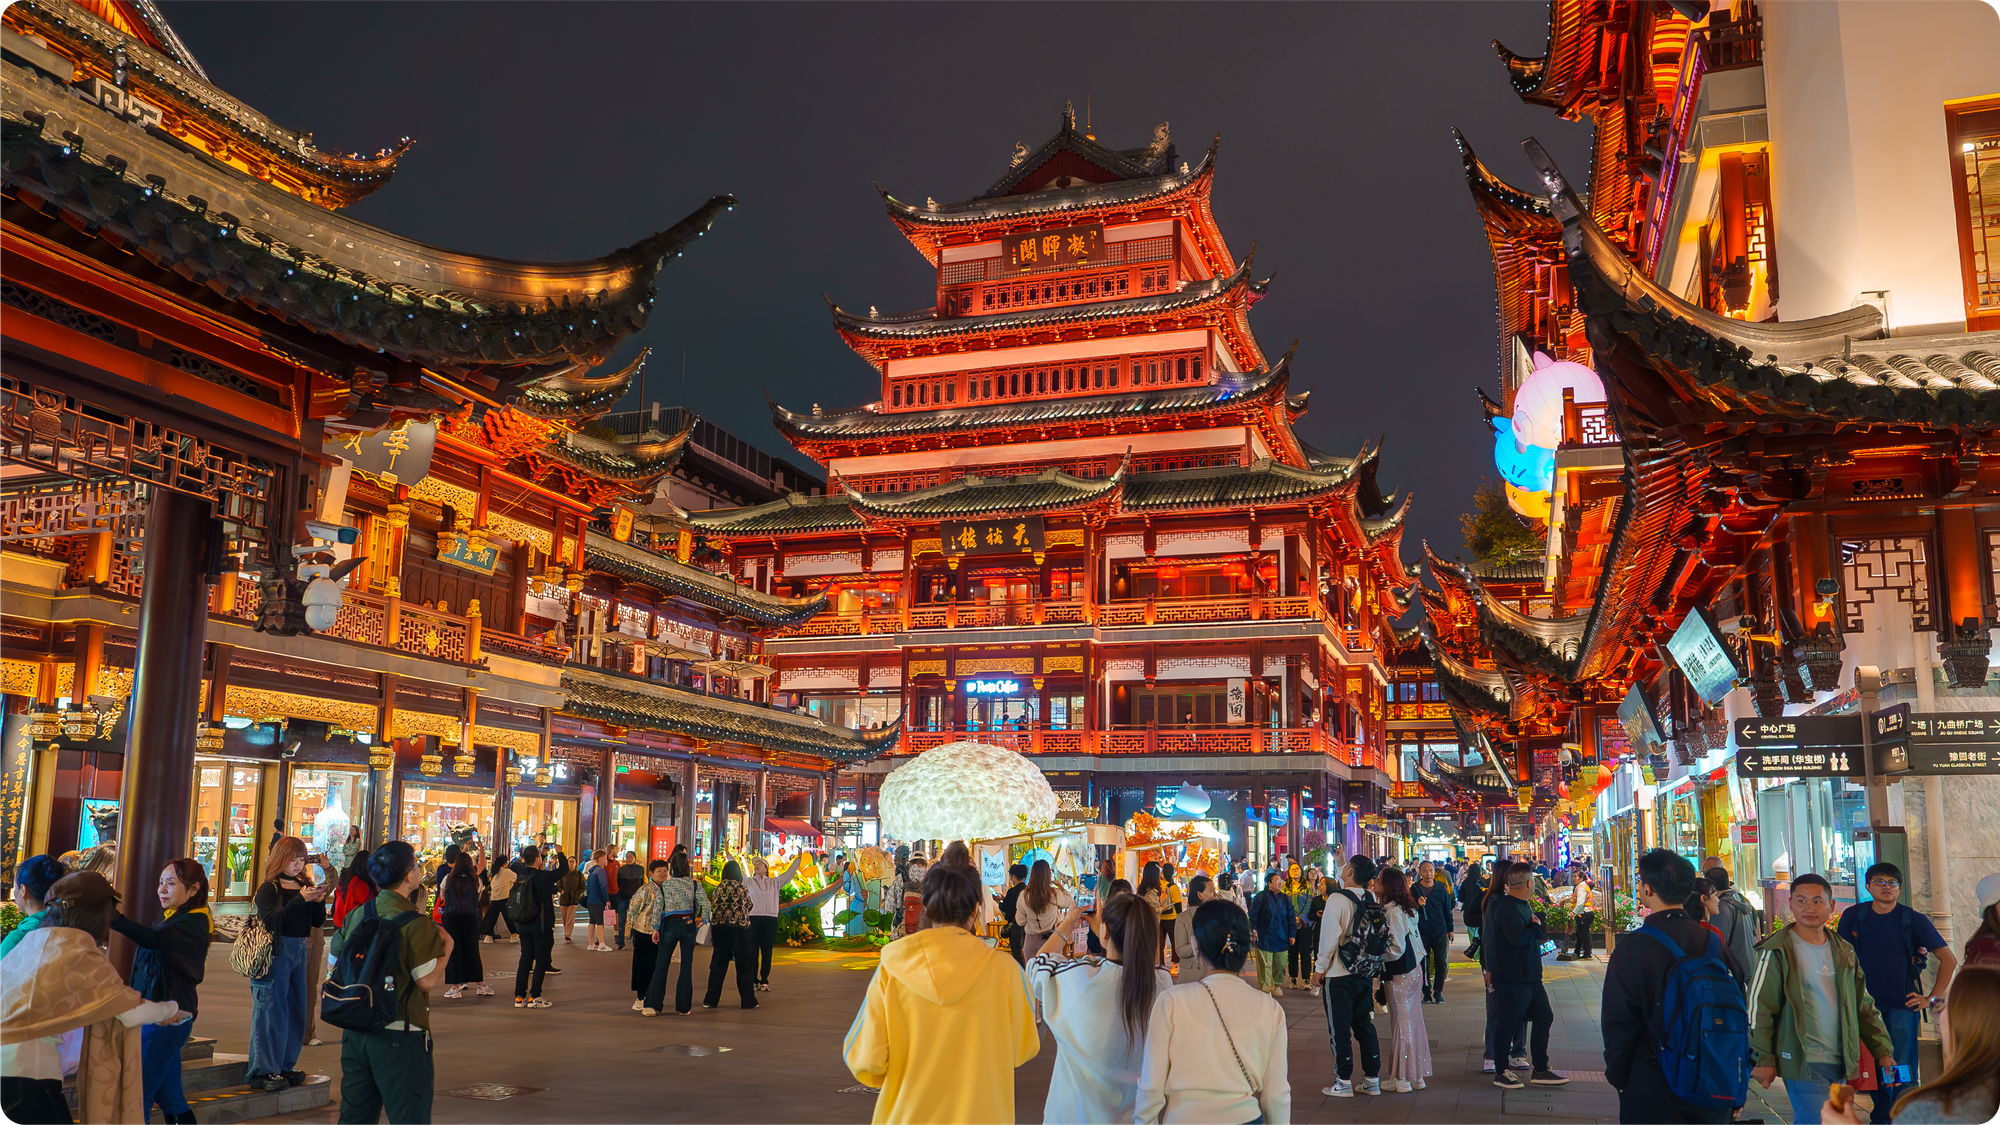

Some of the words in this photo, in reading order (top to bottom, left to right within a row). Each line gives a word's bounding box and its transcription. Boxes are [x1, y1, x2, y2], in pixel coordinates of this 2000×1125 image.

[1760, 724, 1796, 733] 中心广场
[1937, 720, 1984, 729] 九曲桥广场
[1948, 751, 1987, 761] 豫园老街
